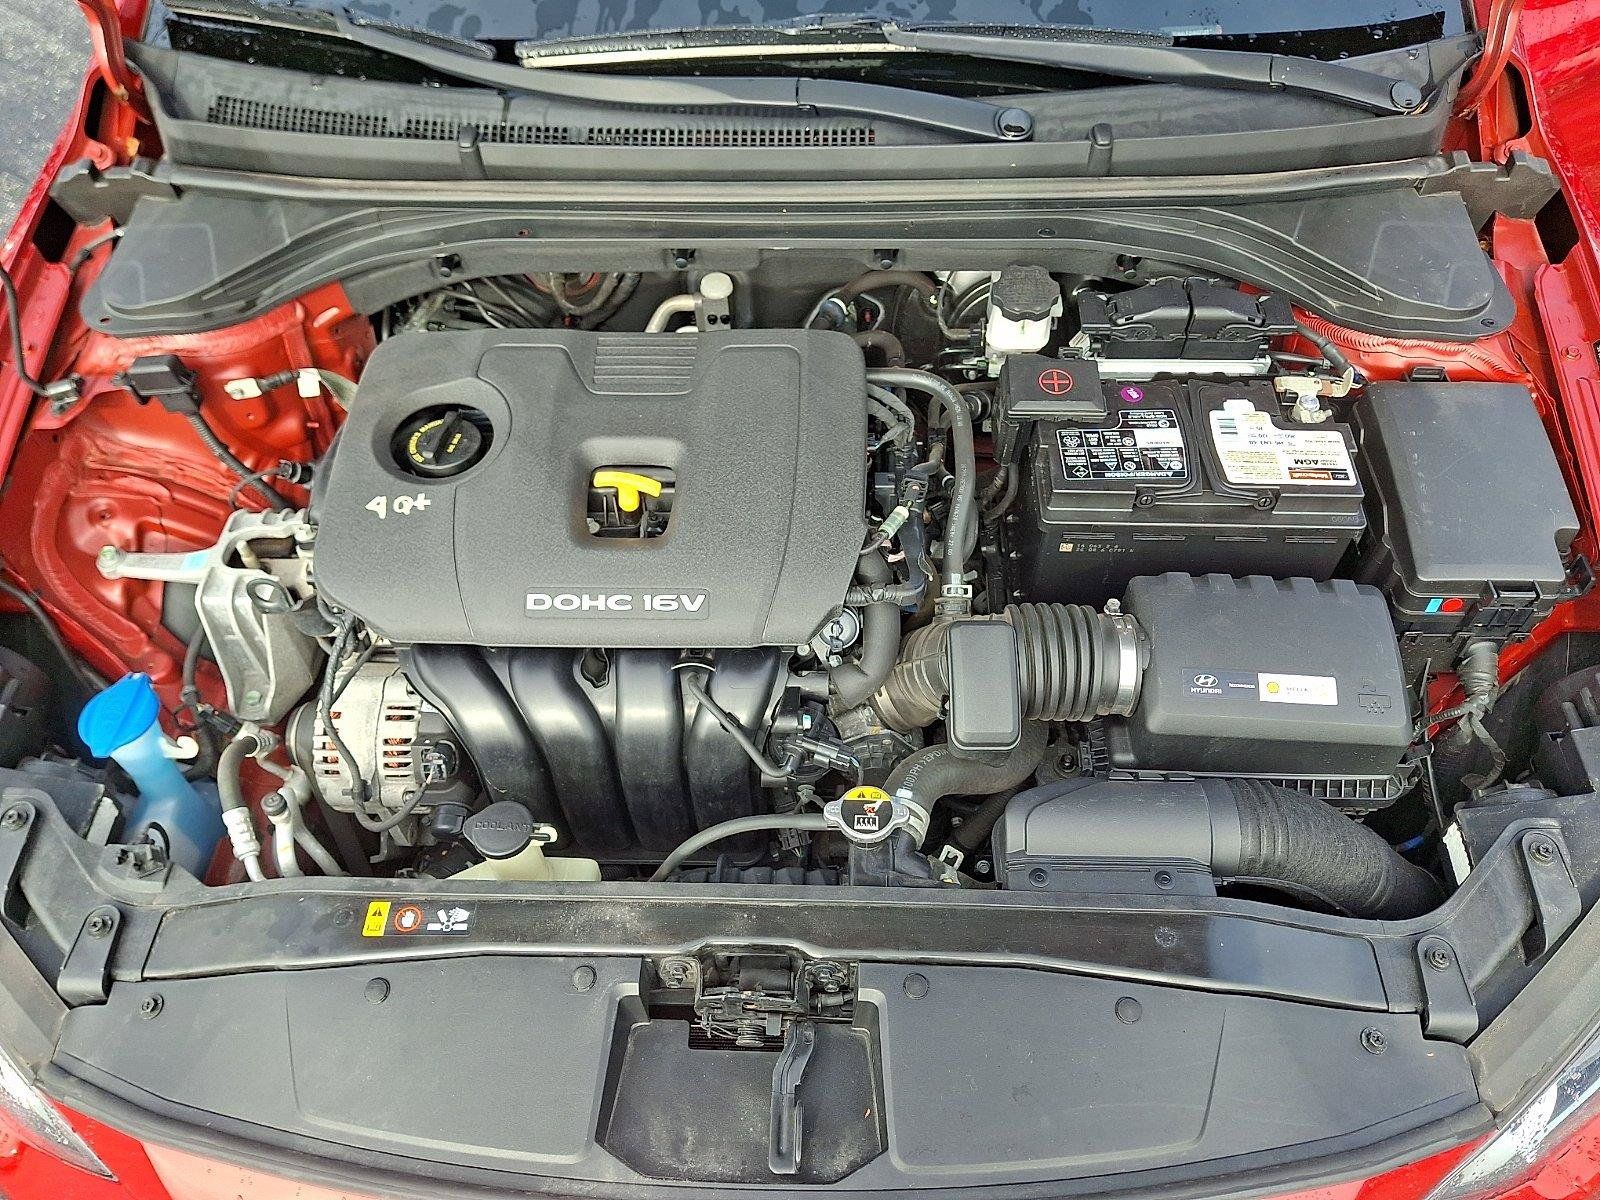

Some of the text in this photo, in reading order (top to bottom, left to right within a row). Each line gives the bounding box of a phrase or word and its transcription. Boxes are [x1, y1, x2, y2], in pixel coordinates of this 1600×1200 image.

[1293, 458, 1319, 466] AGM
[365, 495, 387, 519] 4
[526, 593, 706, 612] DOHC 16V
[1190, 687, 1222, 695] HYUNDAI
